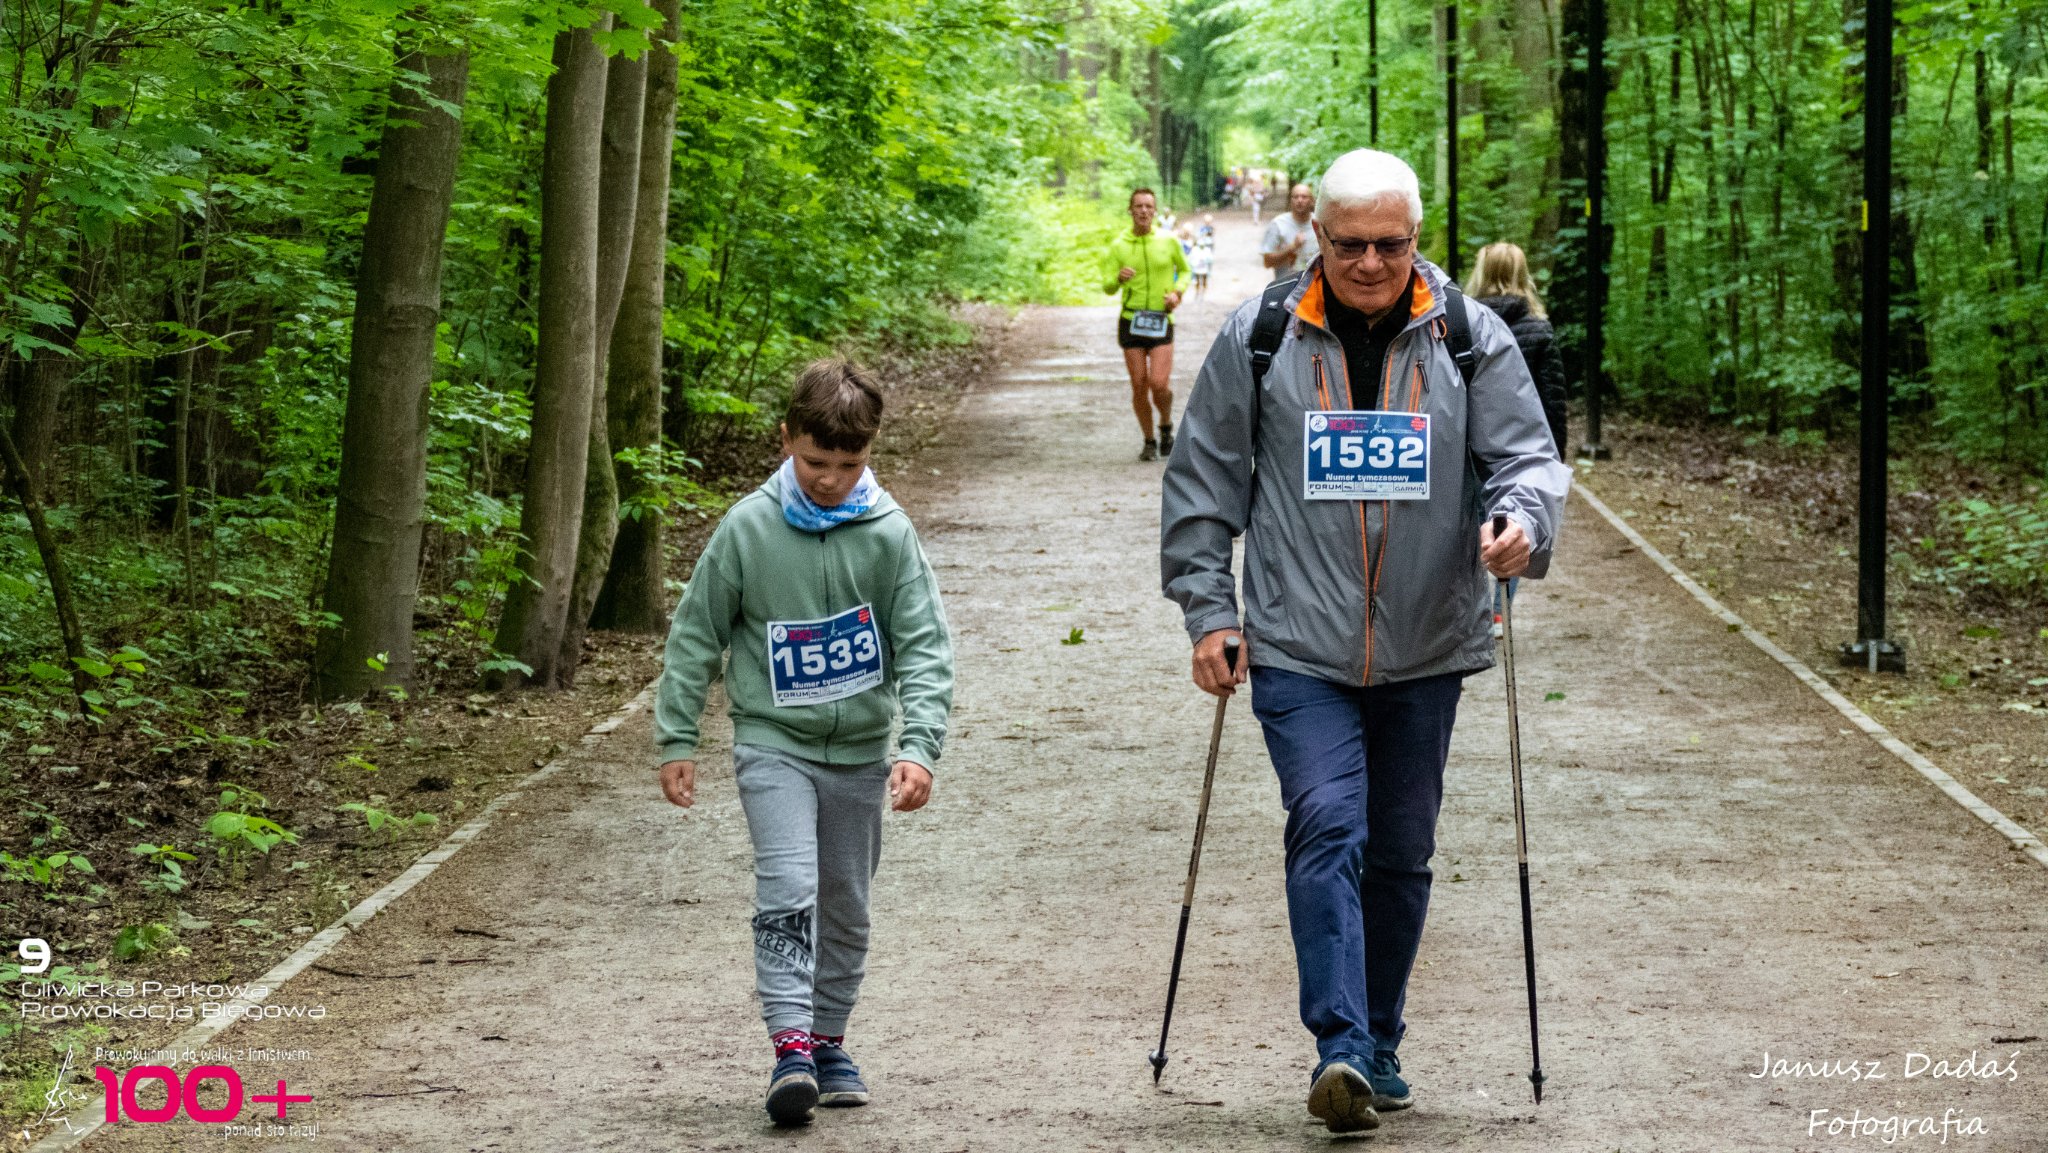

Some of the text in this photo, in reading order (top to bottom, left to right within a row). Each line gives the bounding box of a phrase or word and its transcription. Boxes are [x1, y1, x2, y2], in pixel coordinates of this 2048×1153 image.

[1309, 436, 1424, 468] 1532
[1325, 473, 1409, 483] Numer tymczasowy
[773, 630, 877, 677] 1533
[792, 680, 820, 689] Numer
[822, 668, 867, 686] tymczasowy
[755, 928, 809, 968] URBAN
